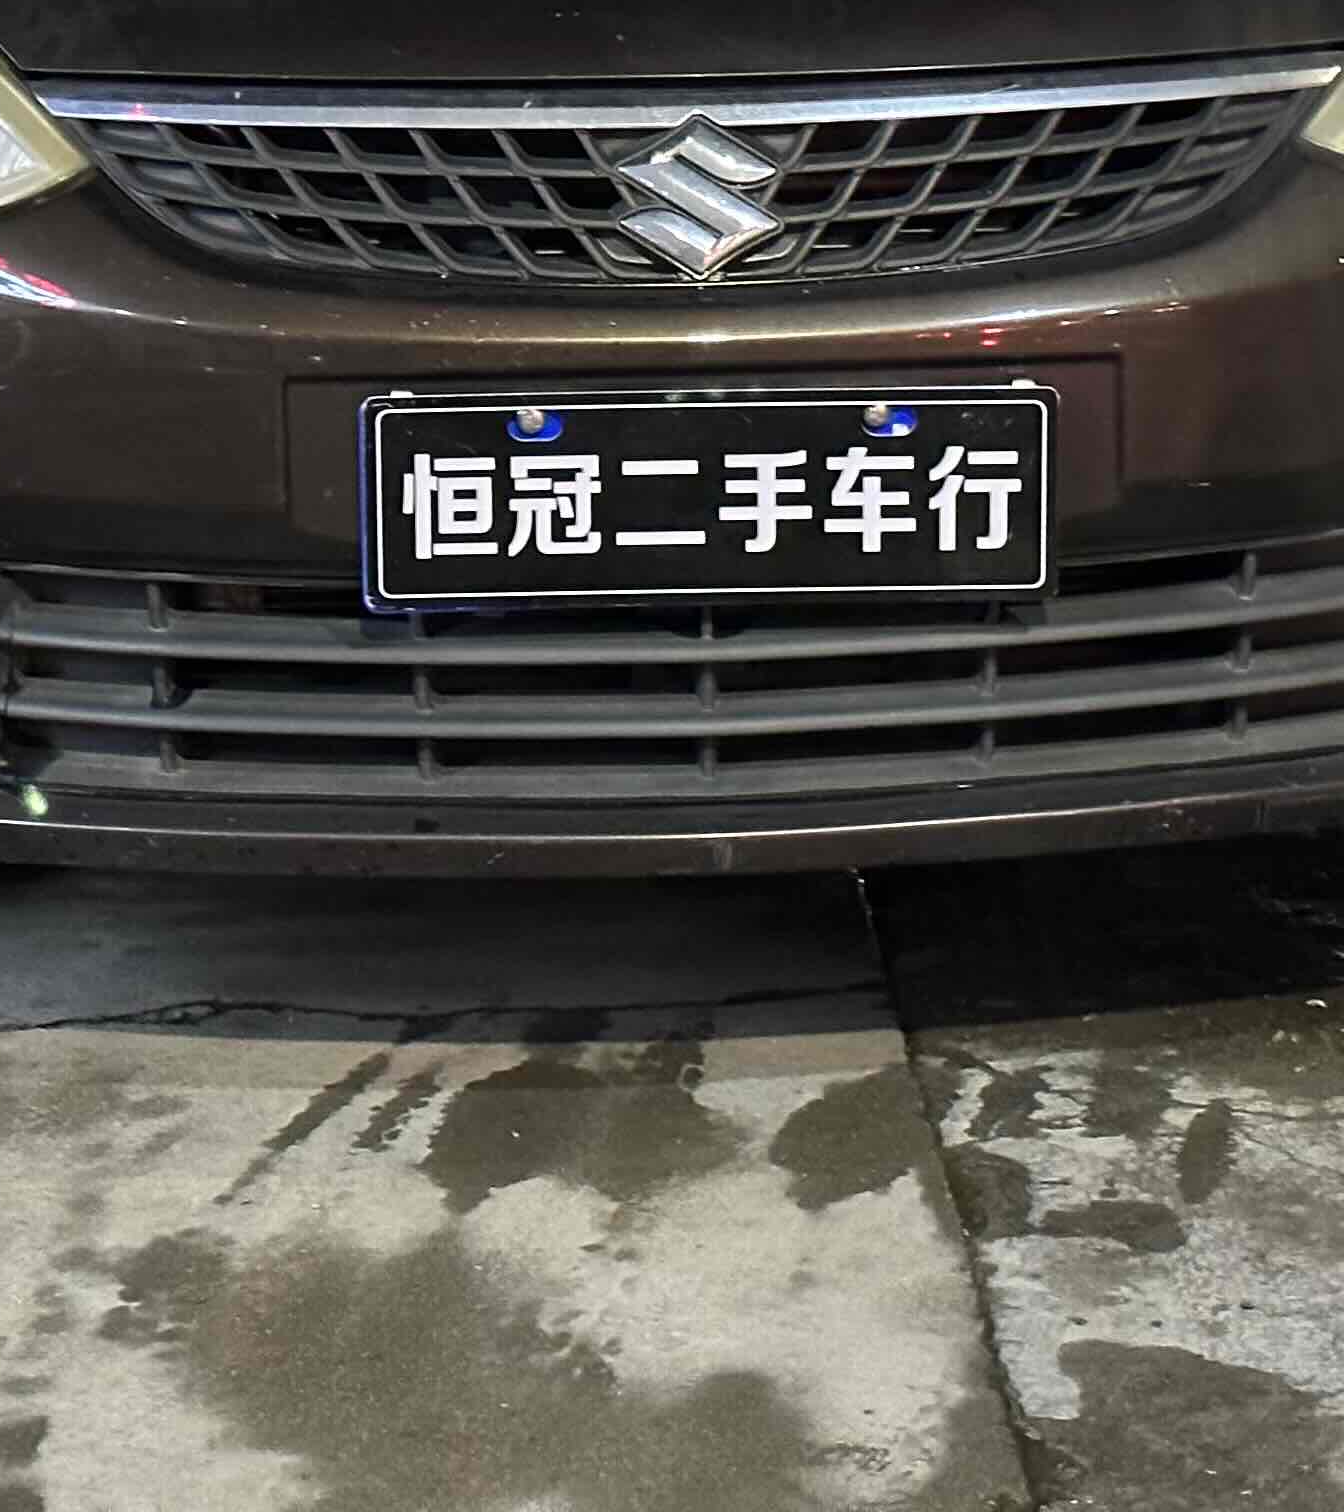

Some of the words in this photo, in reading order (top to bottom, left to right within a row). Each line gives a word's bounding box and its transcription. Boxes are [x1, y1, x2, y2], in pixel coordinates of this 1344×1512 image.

[402, 445, 1023, 561] 恒冠二手车行
